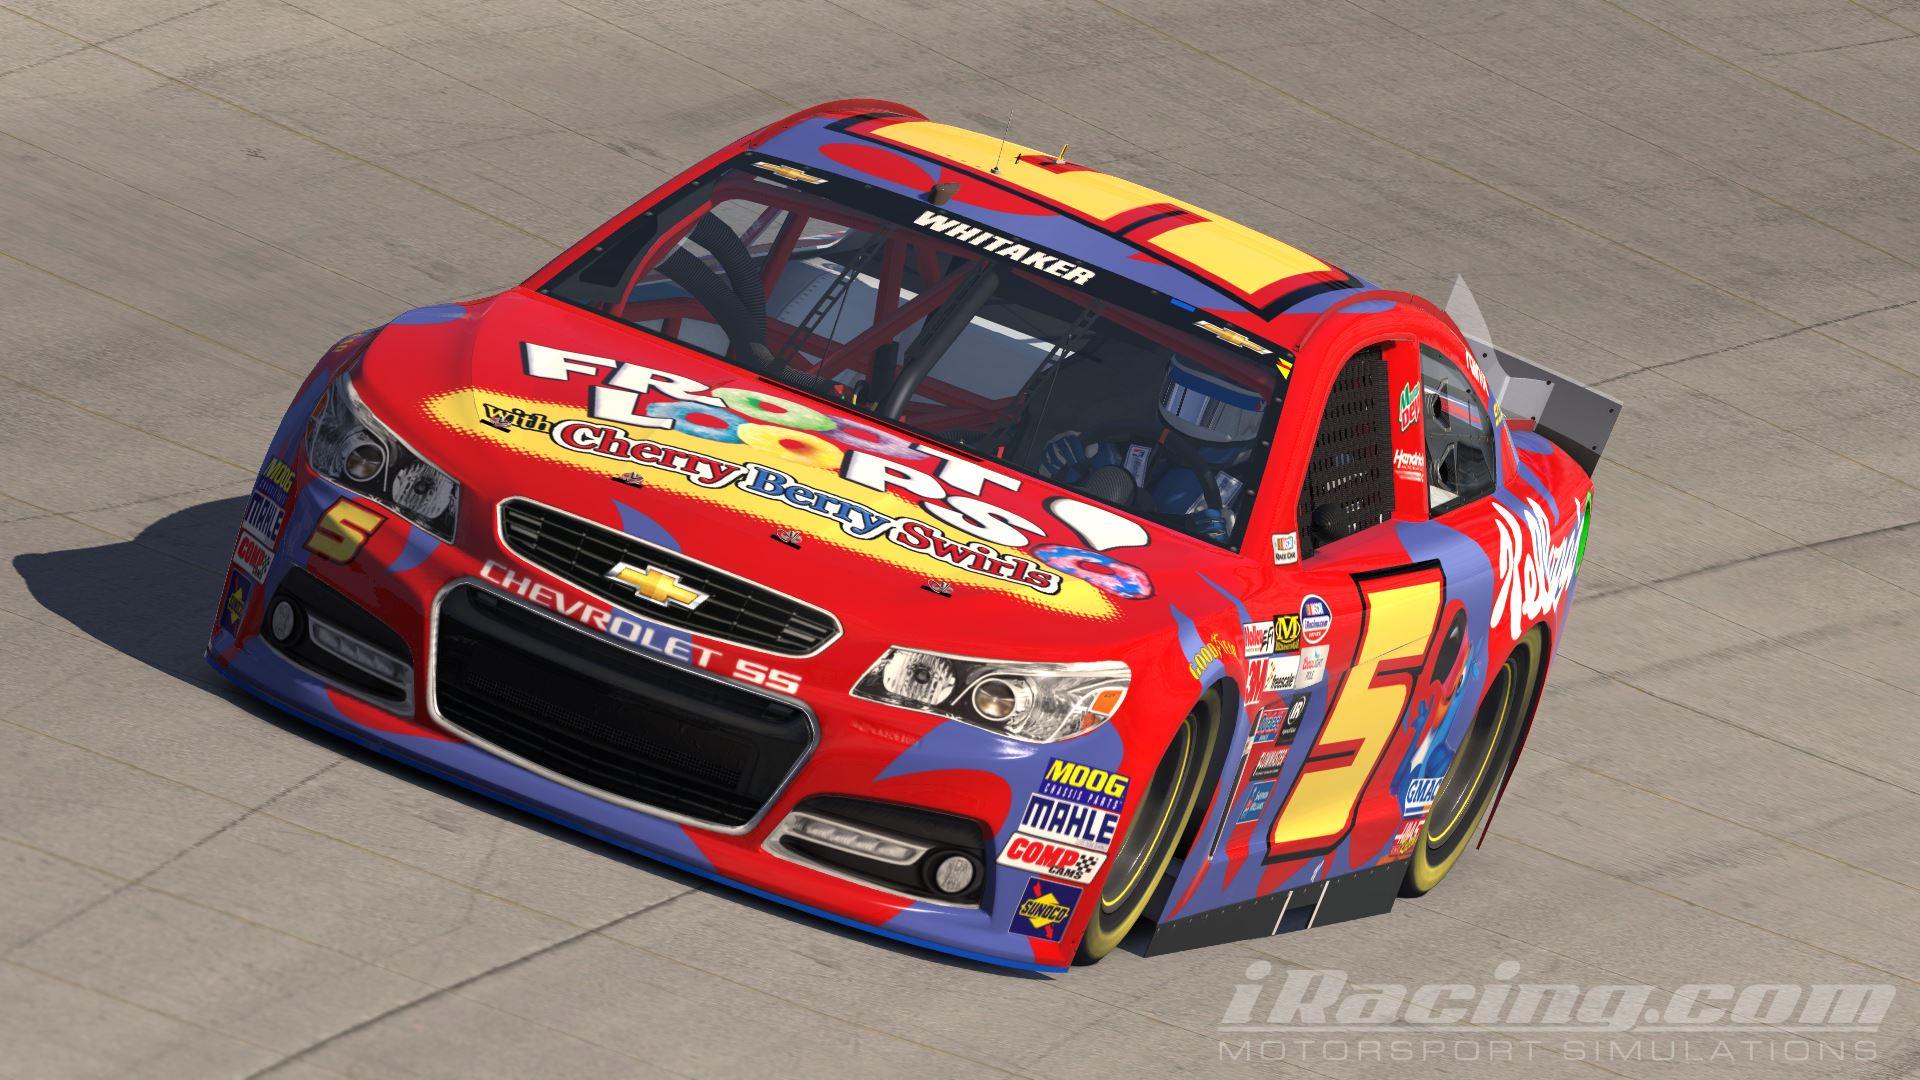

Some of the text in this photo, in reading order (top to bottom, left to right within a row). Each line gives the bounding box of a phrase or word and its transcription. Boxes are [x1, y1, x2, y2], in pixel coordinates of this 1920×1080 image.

[913, 210, 1095, 287] WHITAKER
[520, 341, 1022, 495] FROOT
[483, 403, 1058, 594] with Cherry Berry Swirls
[304, 496, 388, 566] 5
[480, 559, 803, 695] CHEVROLET SS
[1262, 560, 1446, 865] 5
[1044, 783, 1122, 811] CHASSIS PARTS
[1045, 758, 1130, 798] MOOG
[1022, 799, 1119, 845] MAHLE
[1006, 837, 1080, 868] COMP
[1049, 865, 1083, 880] CAMS
[1020, 899, 1069, 922] SUNOCO
